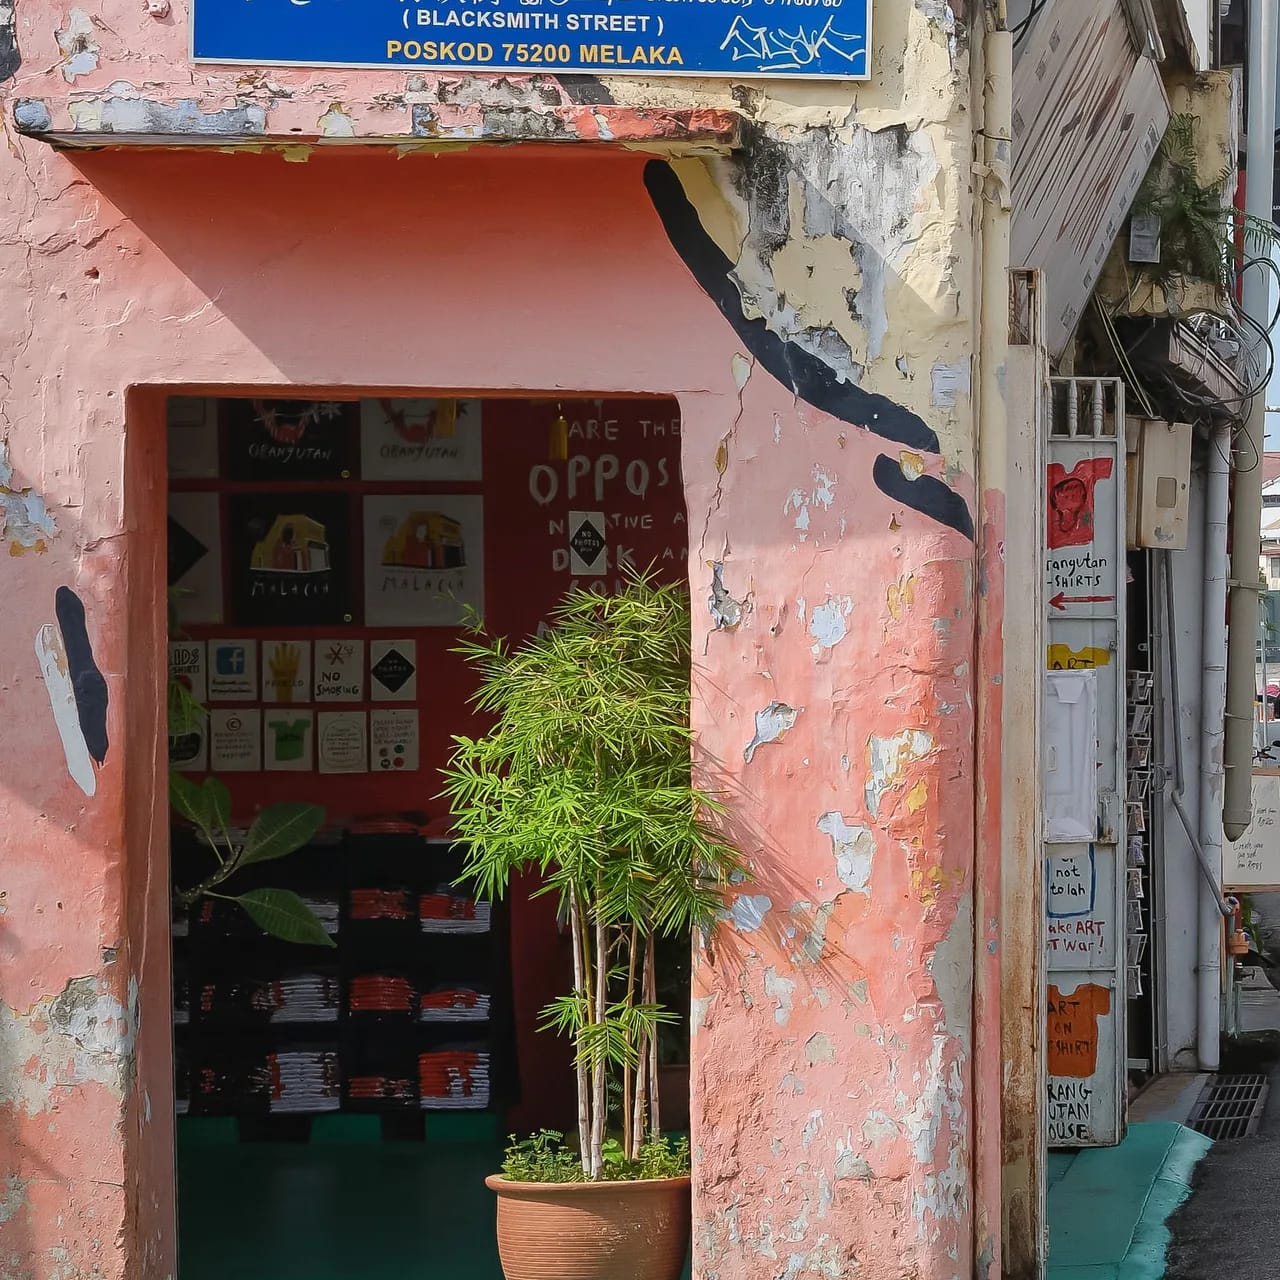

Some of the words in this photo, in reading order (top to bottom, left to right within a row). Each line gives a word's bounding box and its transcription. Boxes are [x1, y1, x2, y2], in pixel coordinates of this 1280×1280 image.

[417, 9, 558, 30] BLACKSMITH
[567, 14, 650, 33] STREET
[386, 40, 494, 63] POSKOD
[502, 44, 571, 63] 75200
[579, 45, 684, 65] MELAKA
[569, 420, 619, 440] ARE
[550, 513, 653, 535] NTIVE
[1047, 552, 1107, 577] rangutan
[170, 648, 200, 665] IDS
[322, 671, 341, 682] NO
[316, 684, 360, 696] SMOKING
[1056, 865, 1081, 877] not
[1050, 882, 1064, 895] to
[1067, 883, 1086, 896] lah
[1048, 920, 1072, 934] ake
[1076, 920, 1105, 937] ART
[1047, 1001, 1080, 1017] ART
[1055, 1022, 1072, 1035] ON
[1047, 1082, 1092, 1102] RANG
[1049, 1103, 1089, 1120] UTAN
[1048, 1122, 1089, 1140] OUSE
